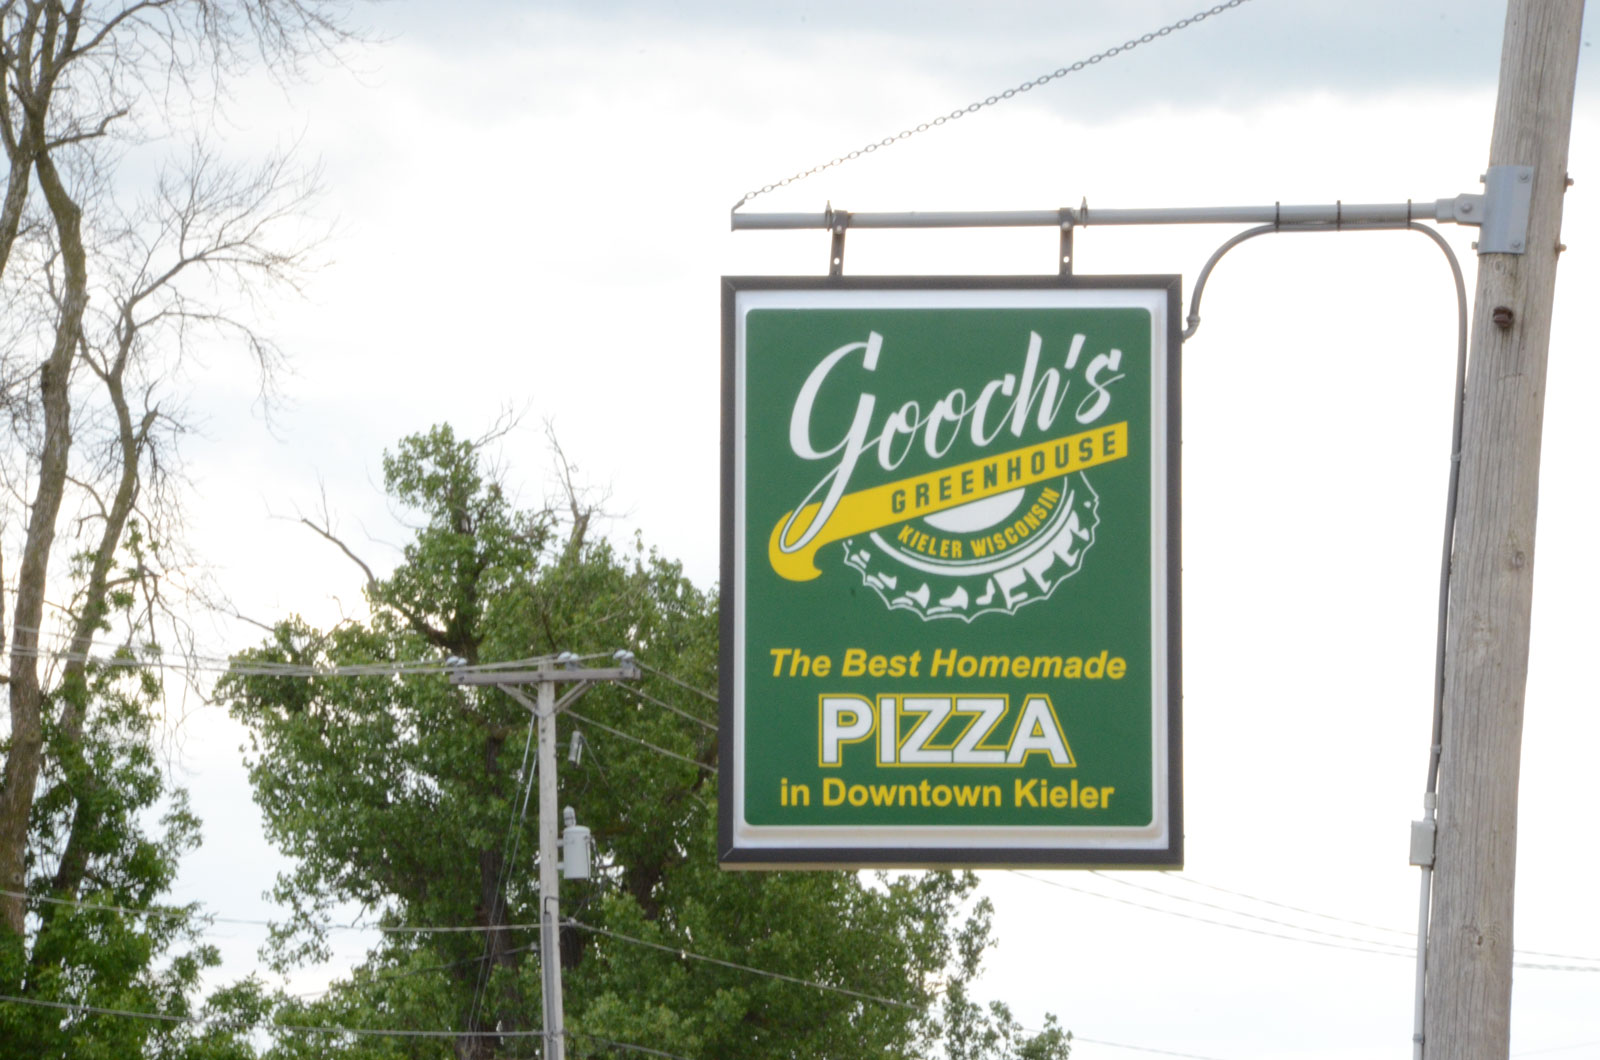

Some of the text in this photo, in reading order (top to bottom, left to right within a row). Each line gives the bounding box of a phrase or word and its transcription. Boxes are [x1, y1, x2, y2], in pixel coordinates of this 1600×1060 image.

[779, 330, 1125, 554] Gooch's
[891, 429, 1117, 515] GREENHOUSE
[897, 486, 1061, 559] KIELER WISCONSIN
[769, 648, 1127, 680] The Best Homemade
[818, 693, 1077, 768] PIZZA
[780, 777, 1115, 809] in Downtown Kieler
